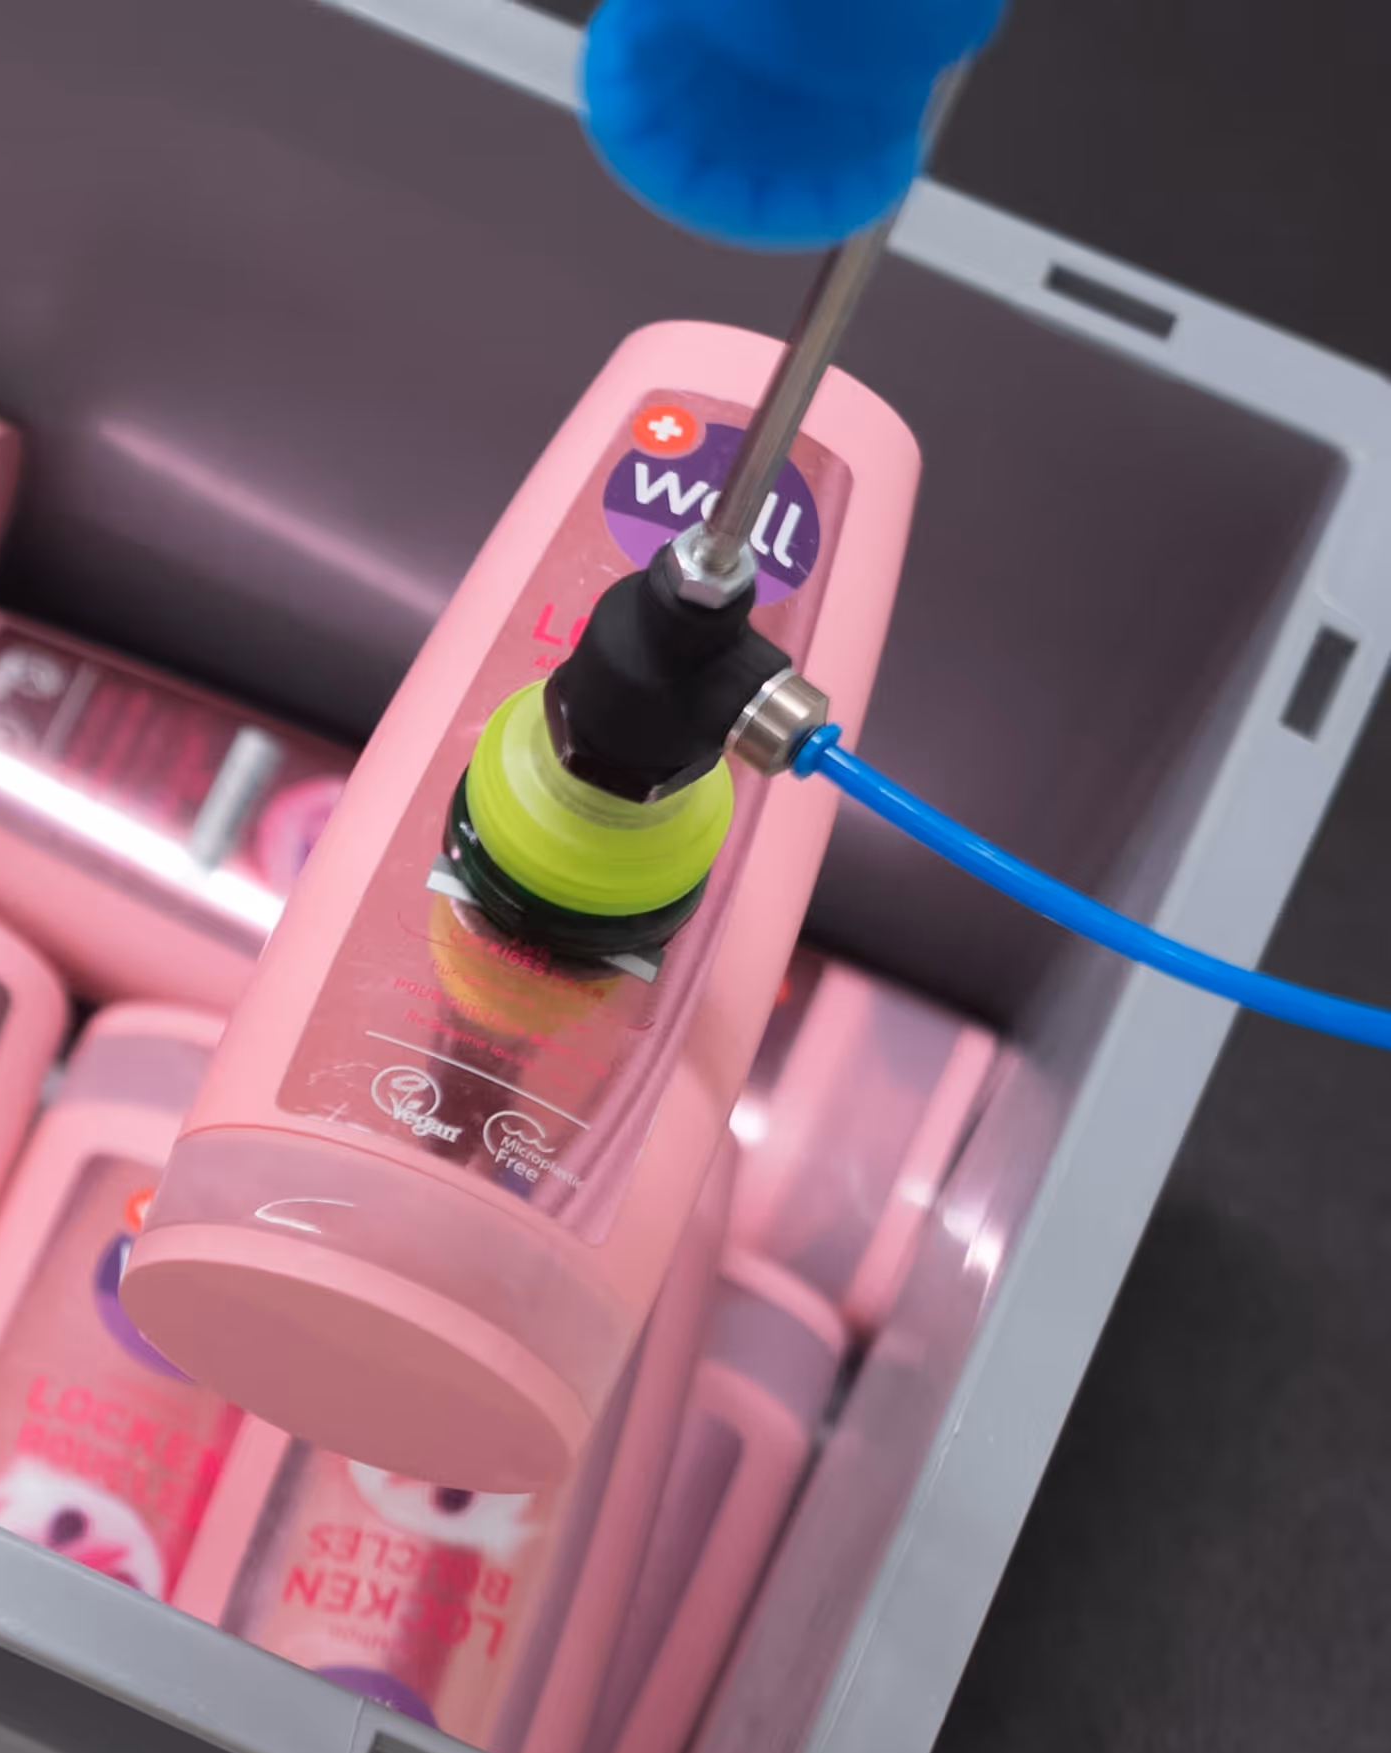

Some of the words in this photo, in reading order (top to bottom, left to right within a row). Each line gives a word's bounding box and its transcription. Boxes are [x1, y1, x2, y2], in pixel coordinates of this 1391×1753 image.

[495, 1148, 540, 1185] Free
[500, 1135, 582, 1189] Microplastic
[307, 1522, 514, 1609] BOUCLES
[282, 1563, 506, 1661] LOCKEN
